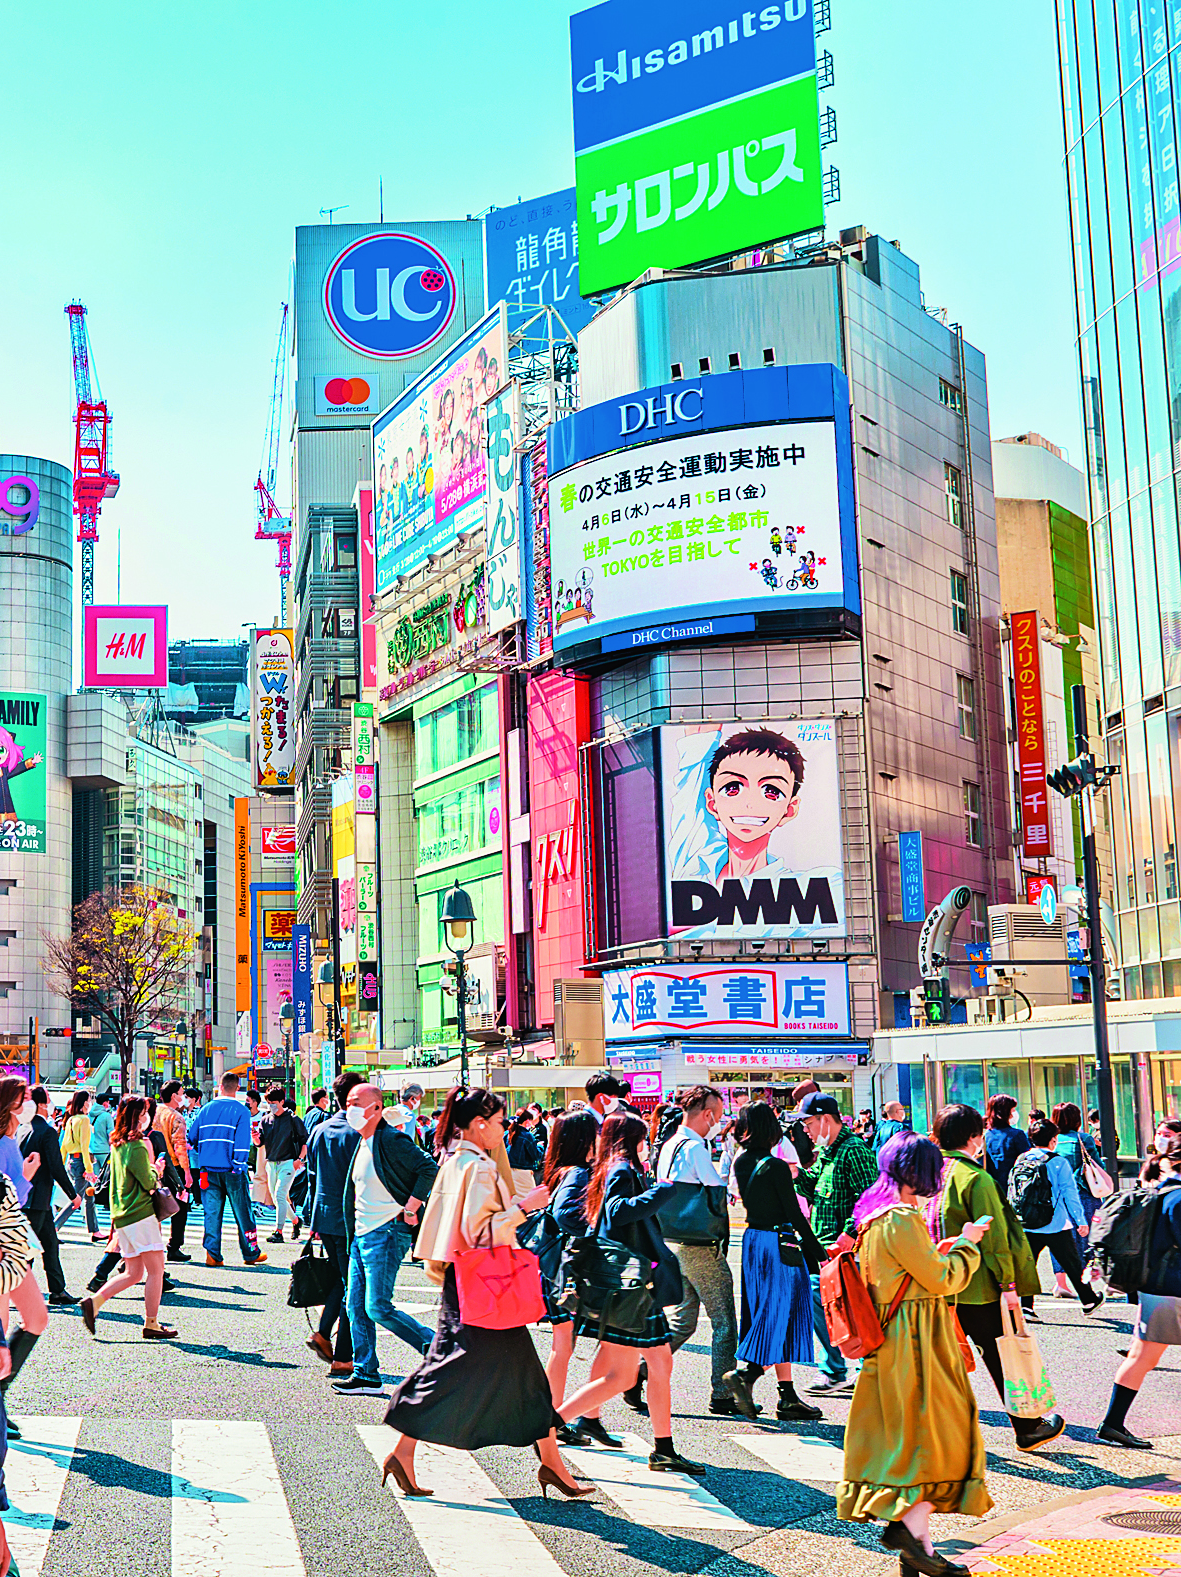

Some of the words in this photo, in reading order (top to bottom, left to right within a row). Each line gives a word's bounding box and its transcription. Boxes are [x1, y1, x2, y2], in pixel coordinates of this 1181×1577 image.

[591, 127, 804, 245] サロンパス
[326, 405, 369, 413] mastercard
[618, 387, 704, 436] DHC
[560, 443, 806, 513] 春の交通安全運動実施中
[583, 509, 770, 561] 世界一の交通安全都市
[602, 537, 742, 578] TOKYOを目指して
[105, 632, 147, 661] H&M
[631, 632, 660, 645] DHC
[661, 621, 714, 641] Channel
[1016, 618, 1039, 752] クスリのことなら
[797, 732, 833, 742] ダンスール
[1022, 761, 1050, 846] 三千里
[22, 840, 39, 849] AIR
[238, 826, 247, 861] KiYoshi
[238, 862, 247, 918] Matsumoto
[905, 836, 919, 917] 大盛堂商事ビル
[670, 877, 838, 926] DMM
[298, 934, 307, 973] MIZUHO
[297, 1000, 306, 1038] みずほ銀
[612, 975, 827, 1024] 大盛堂書店
[784, 1022, 806, 1030] BOOKS
[808, 1022, 839, 1030] TAISEIDO
